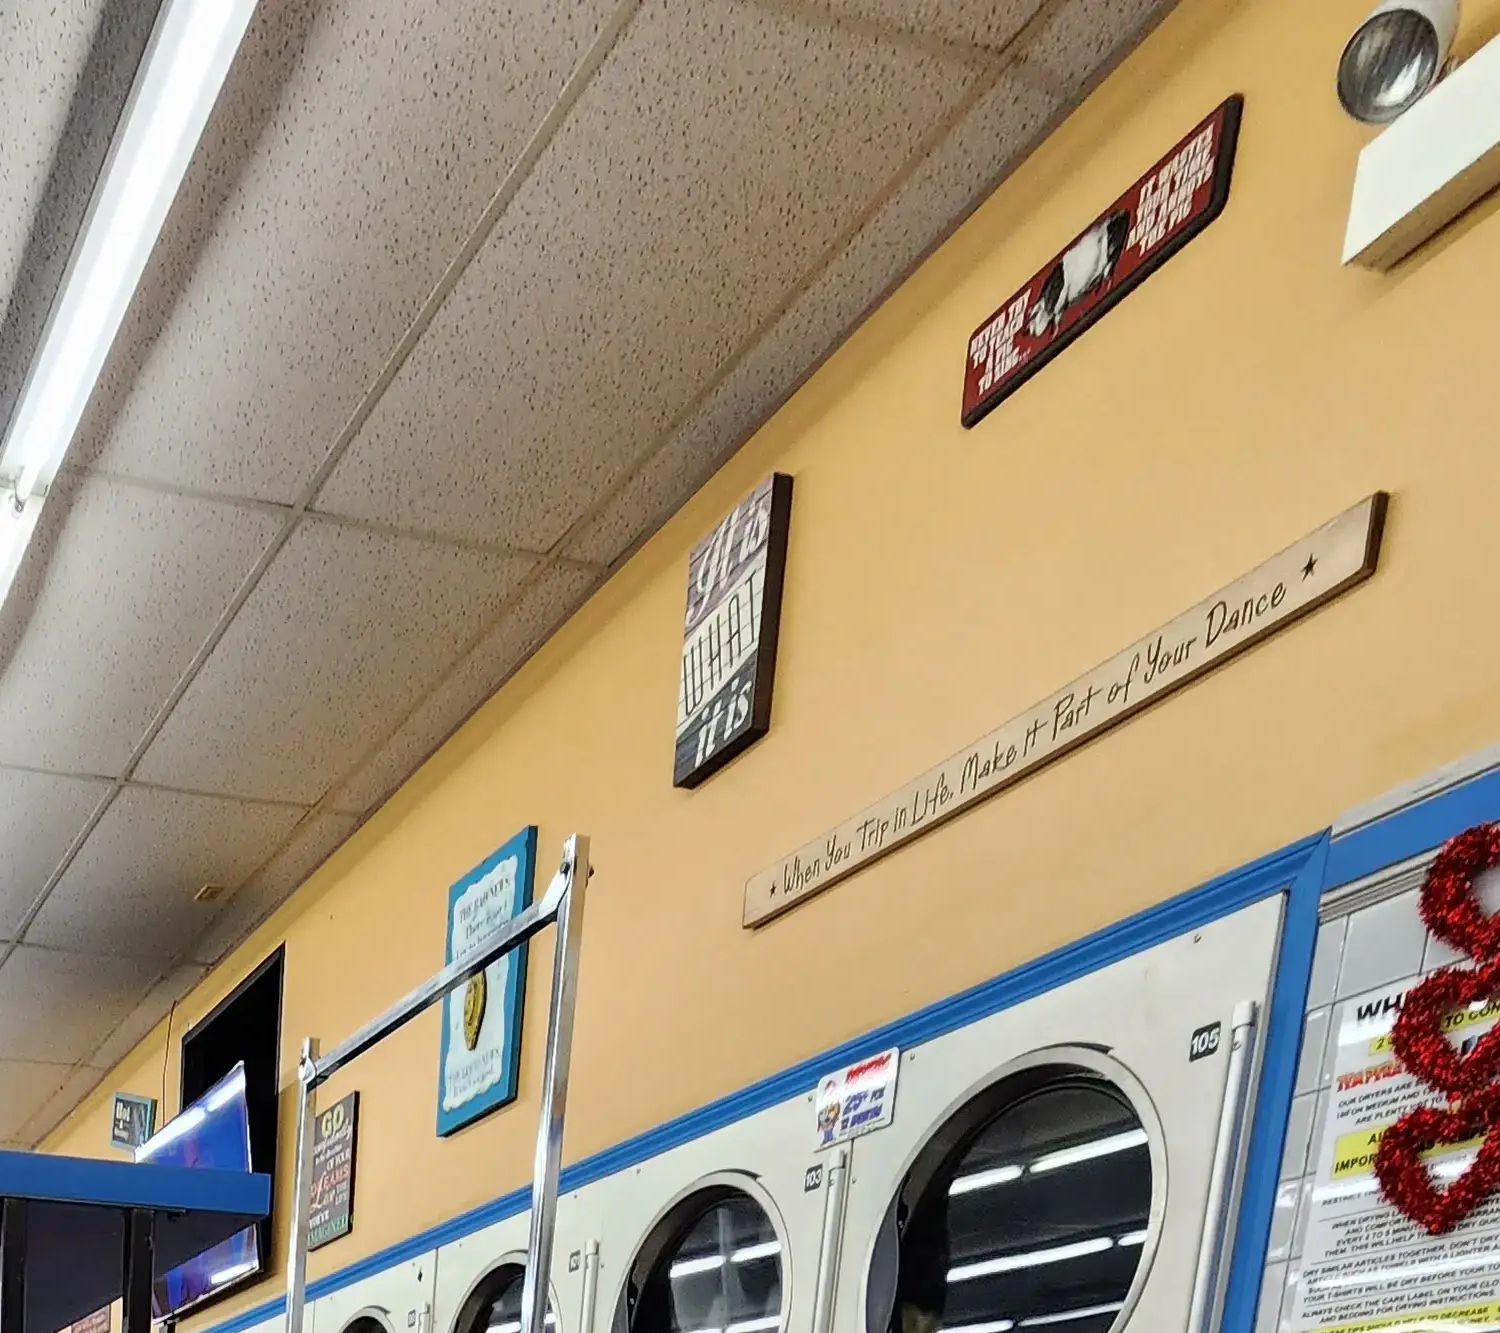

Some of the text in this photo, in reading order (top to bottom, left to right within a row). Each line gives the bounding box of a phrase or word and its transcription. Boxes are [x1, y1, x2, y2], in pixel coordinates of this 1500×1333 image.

[1158, 125, 1212, 184] WASTES
[1174, 144, 1210, 188] TIME
[1168, 195, 1191, 229] PIG
[683, 569, 756, 717] WHAT
[694, 677, 752, 768] it is
[784, 856, 819, 892] When
[825, 835, 850, 870] You
[856, 818, 888, 850] Trip
[893, 807, 906, 832] in
[960, 743, 1016, 792] Make
[1023, 719, 1047, 754] it
[1052, 687, 1100, 739] Part
[1107, 653, 1139, 703] of
[1144, 636, 1192, 682] Your
[1206, 584, 1285, 646] Dance
[1445, 1012, 1464, 1028] TO
[1192, 1028, 1219, 1055] 105
[1338, 1081, 1411, 1107] OUR DRYERS ARE
[322, 1105, 344, 1138] GO
[1355, 1114, 1371, 1124] ARE
[806, 1168, 822, 1188] 103
[1302, 1307, 1332, 1317] ALWAYS
[1364, 1299, 1379, 1307] THE
[1382, 1295, 1404, 1304] CARE
[1407, 1290, 1433, 1300] LABEL
[1453, 1282, 1477, 1292] YOUR
[1303, 1294, 1324, 1302] YOUR
